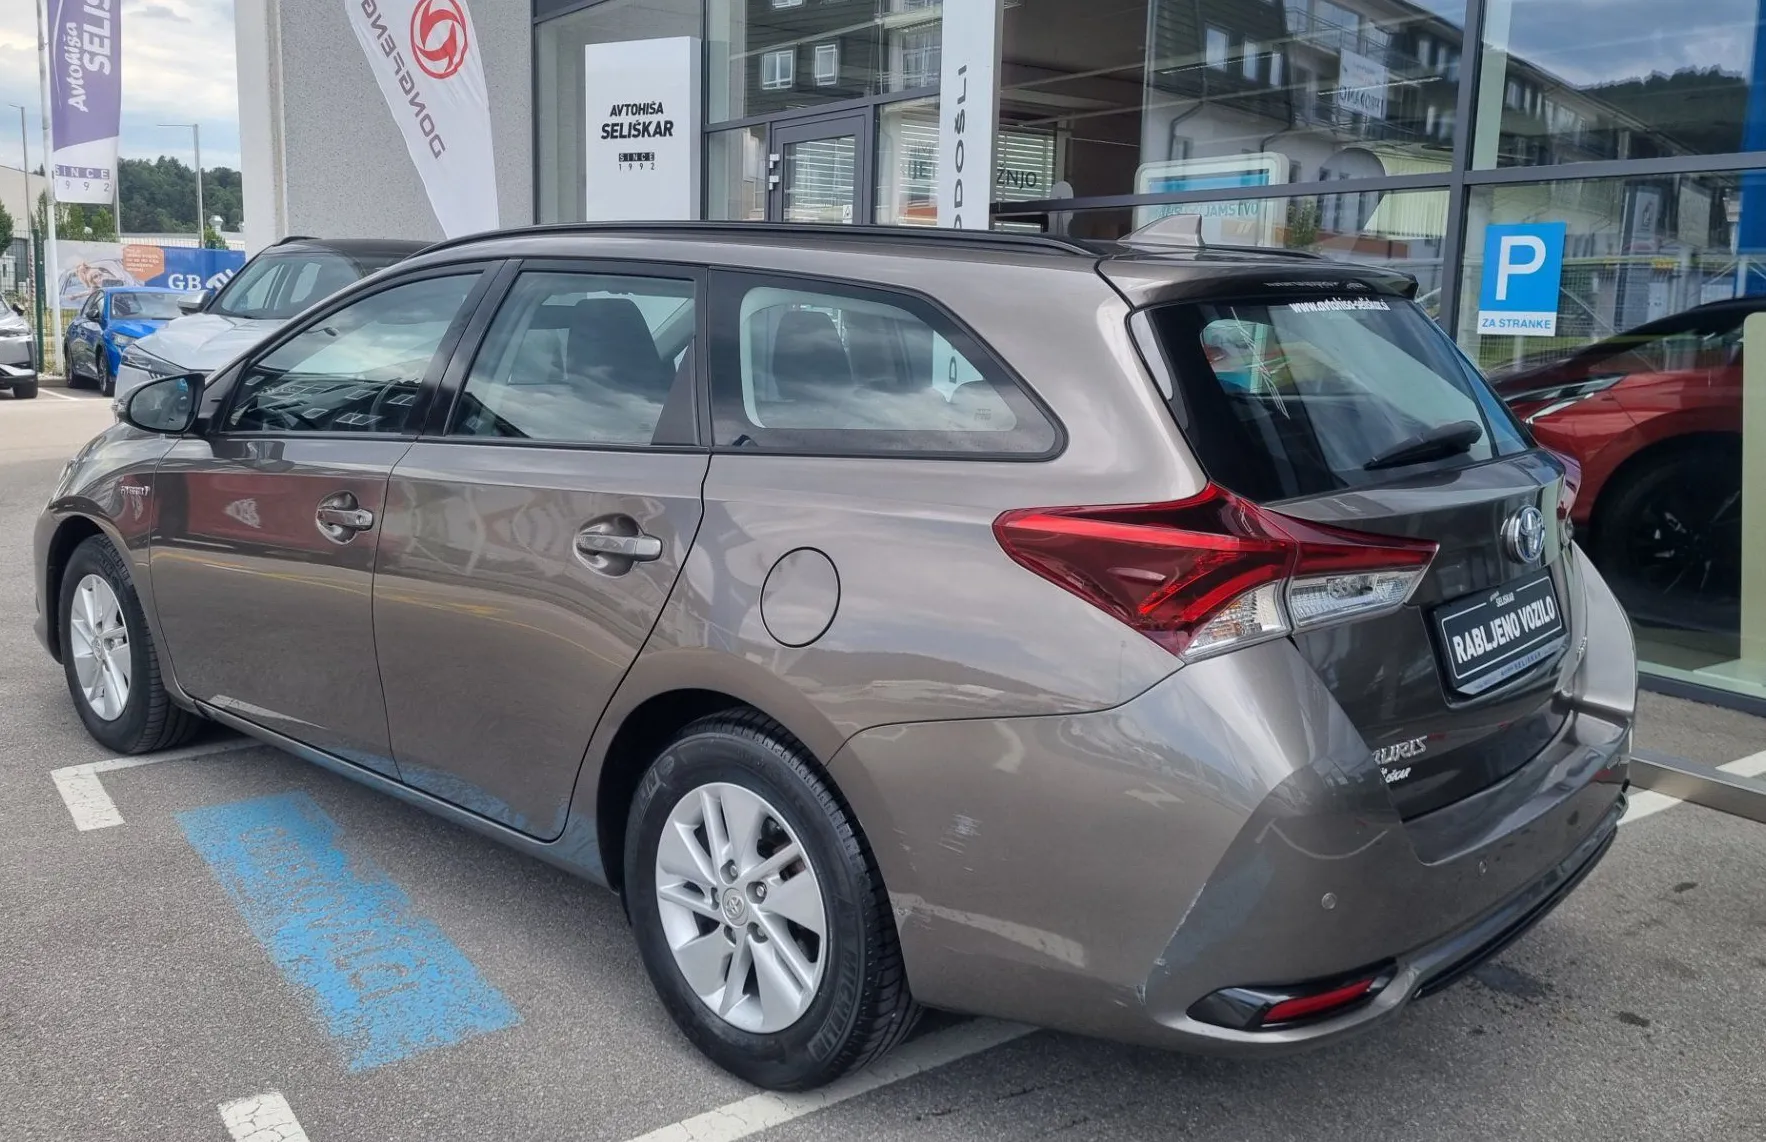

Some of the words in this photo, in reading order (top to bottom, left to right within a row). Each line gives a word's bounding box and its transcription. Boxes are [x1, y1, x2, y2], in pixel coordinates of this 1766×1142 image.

[609, 101, 664, 117] AVTOHIŠA
[601, 119, 674, 139] SELIŠKAR
[619, 152, 655, 162] SINCE
[55, 165, 109, 179] SINCE
[619, 162, 655, 171] 1992
[996, 163, 1037, 189] ŽNJO
[1495, 235, 1546, 301] P
[168, 273, 202, 291] GB
[1482, 318, 1496, 328] ZA
[1498, 318, 1551, 330] STRANKE
[1452, 612, 1521, 664] RABLJENO
[1517, 595, 1556, 633] VOZILO
